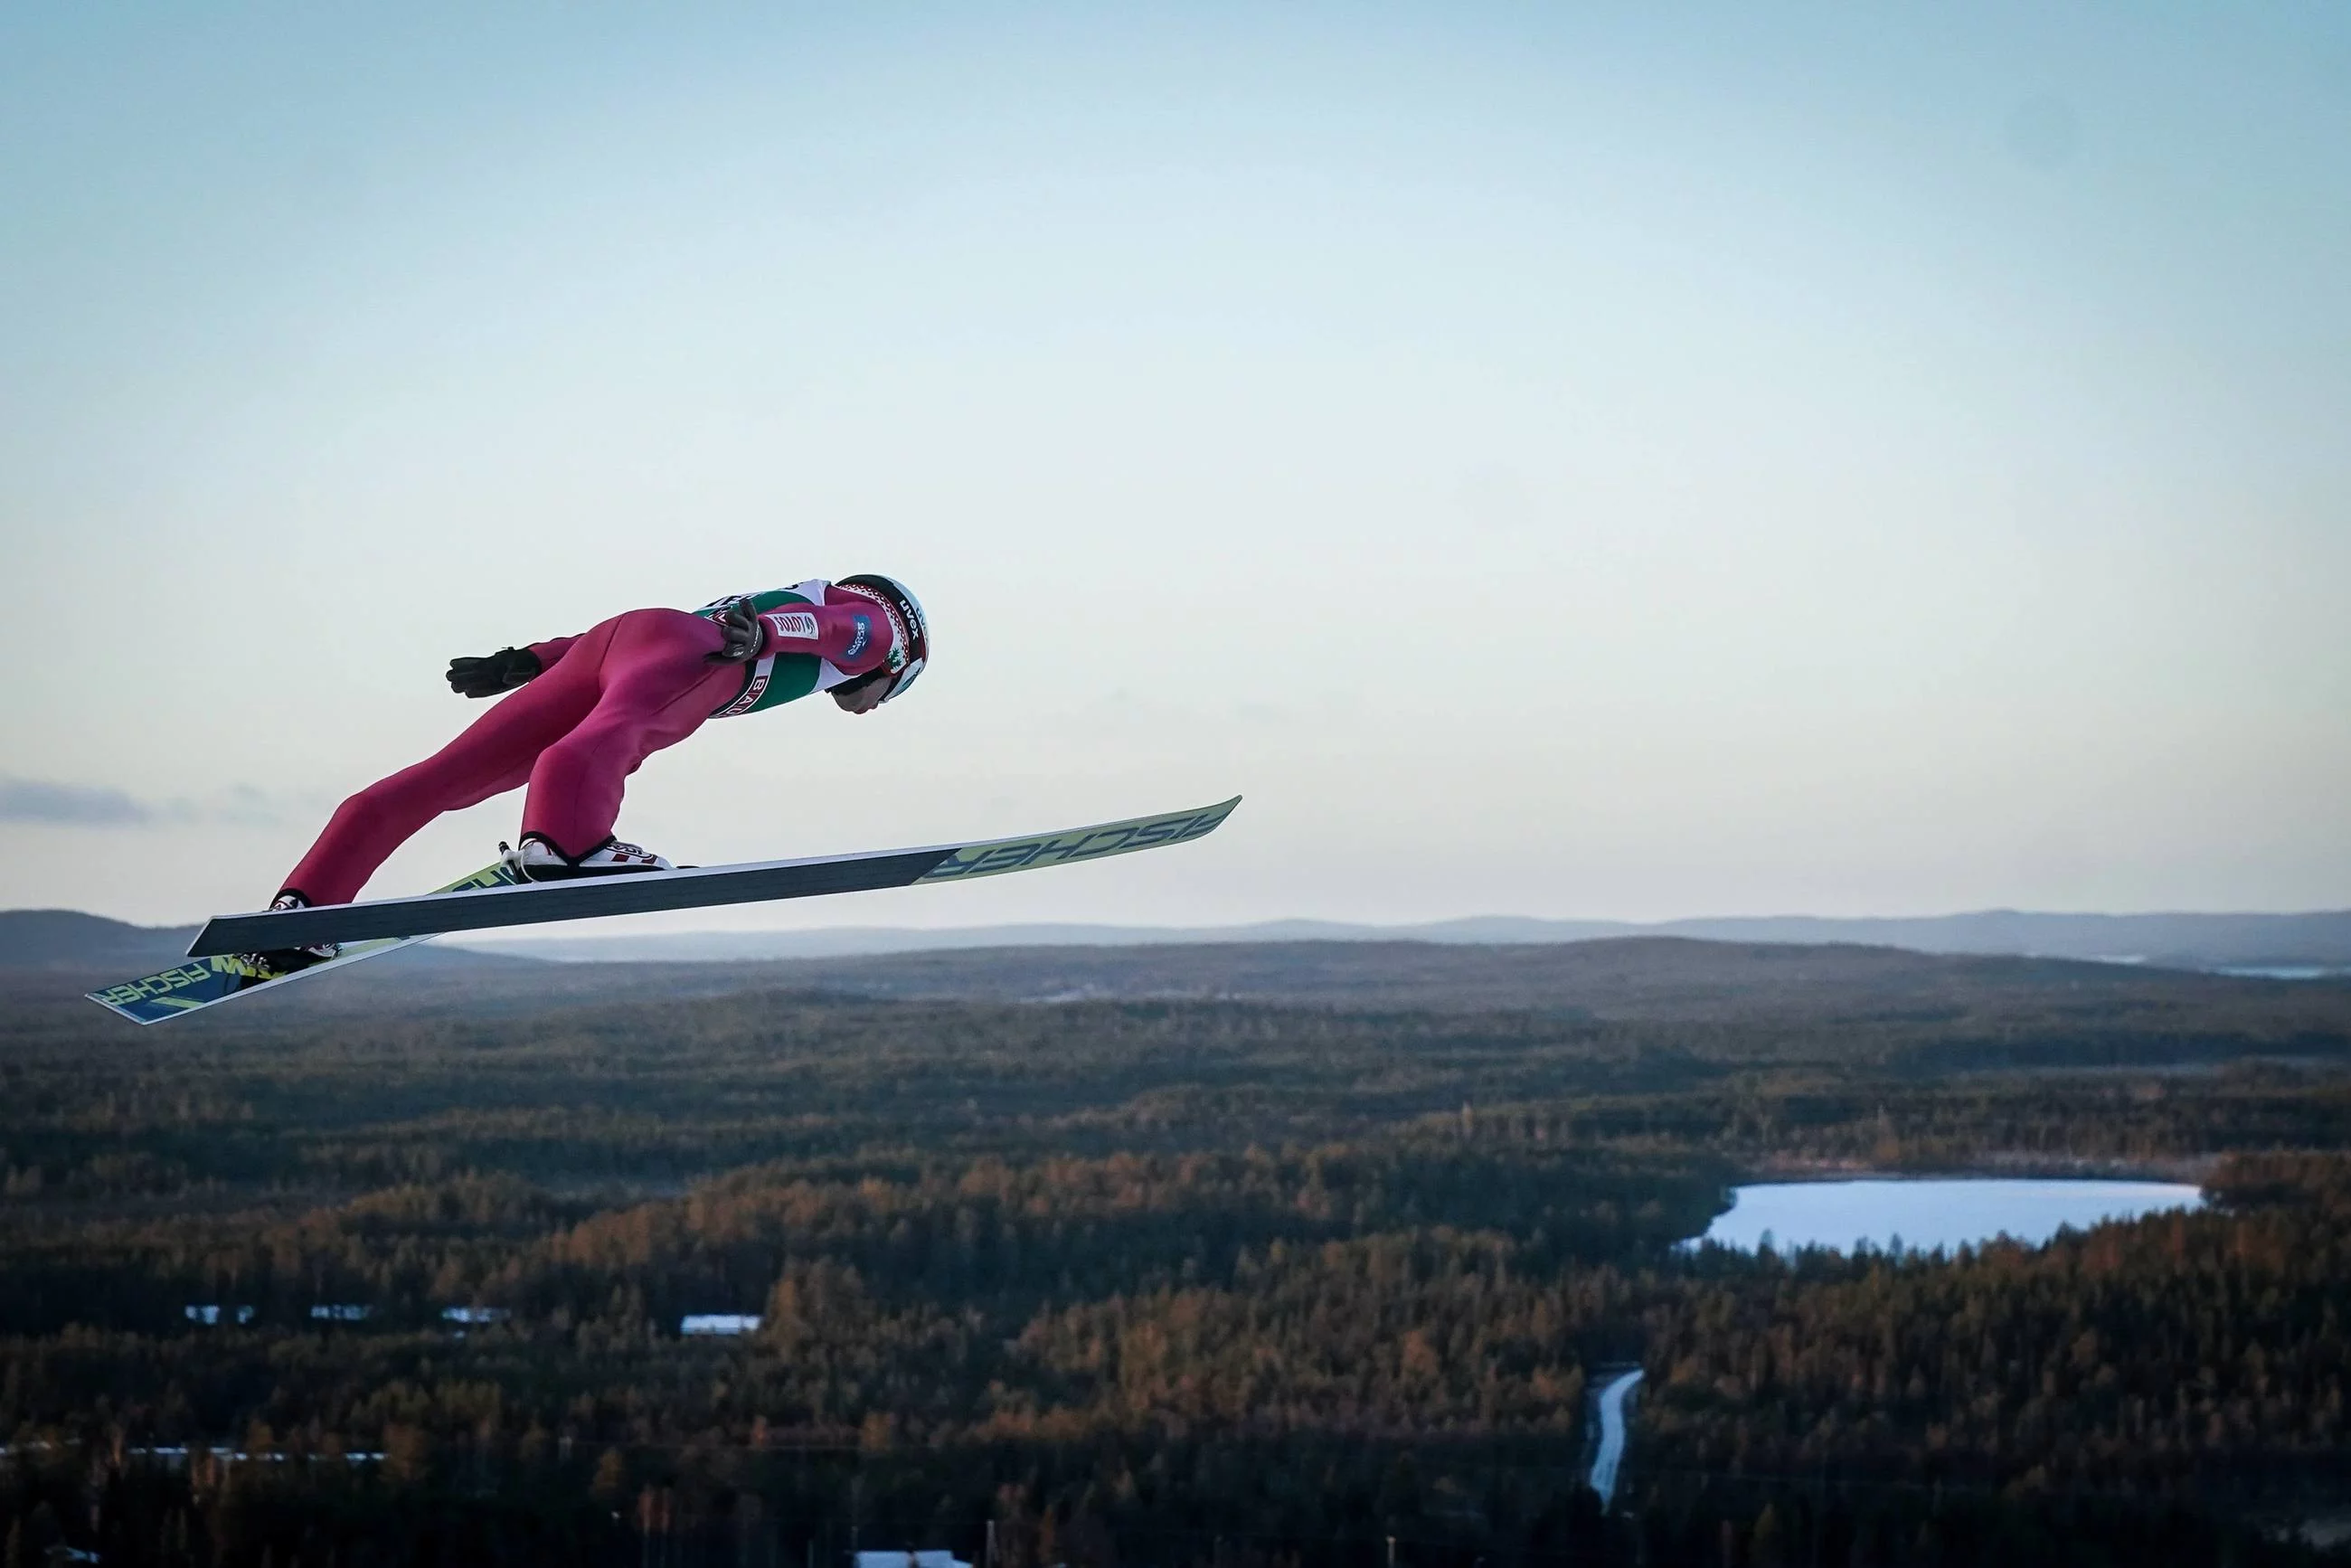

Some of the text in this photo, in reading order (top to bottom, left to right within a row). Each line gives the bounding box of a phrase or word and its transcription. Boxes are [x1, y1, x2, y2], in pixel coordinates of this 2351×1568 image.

[900, 600, 920, 640] uvex
[922, 812, 1230, 879] FISCHER
[96, 961, 212, 1006] FISCHER
